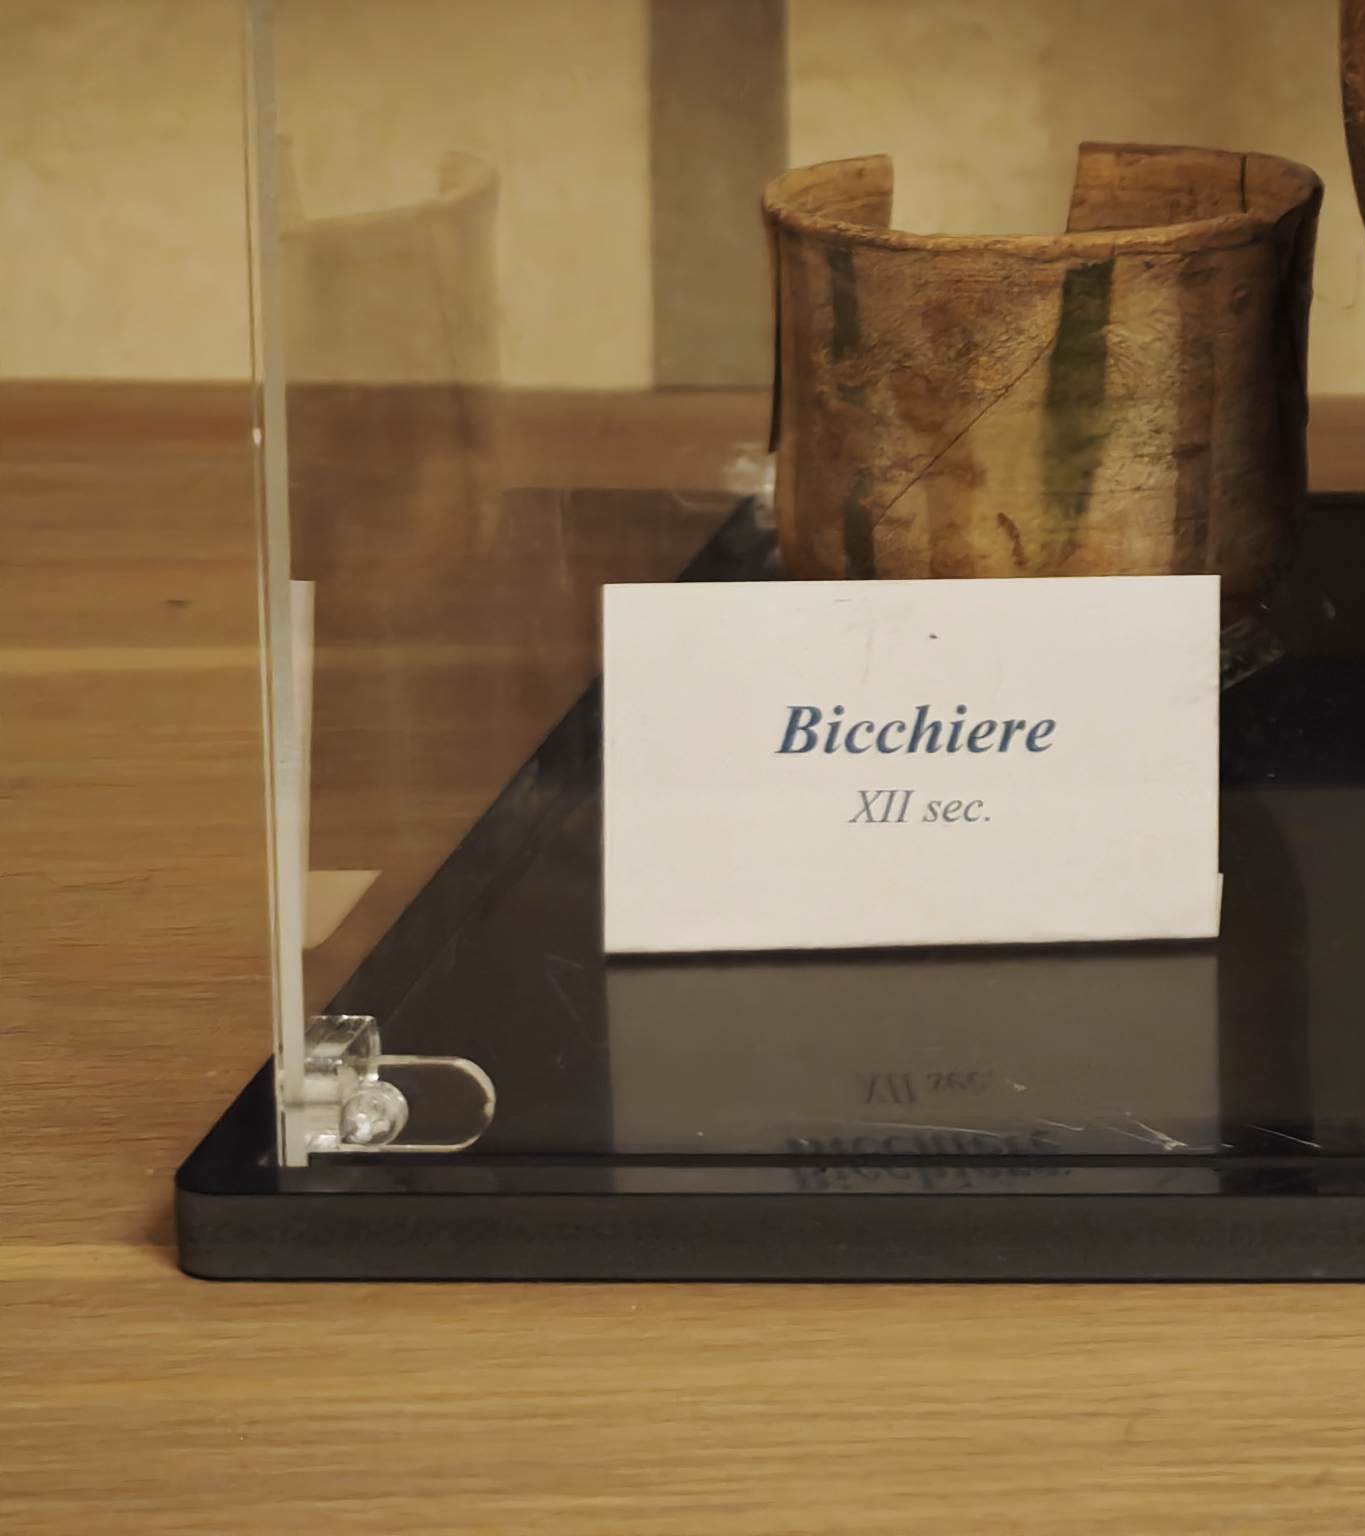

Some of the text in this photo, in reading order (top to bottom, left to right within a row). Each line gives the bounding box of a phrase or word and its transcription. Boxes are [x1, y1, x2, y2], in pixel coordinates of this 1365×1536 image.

[773, 703, 1057, 755] Bicchiere
[848, 788, 992, 825] XII sec.
